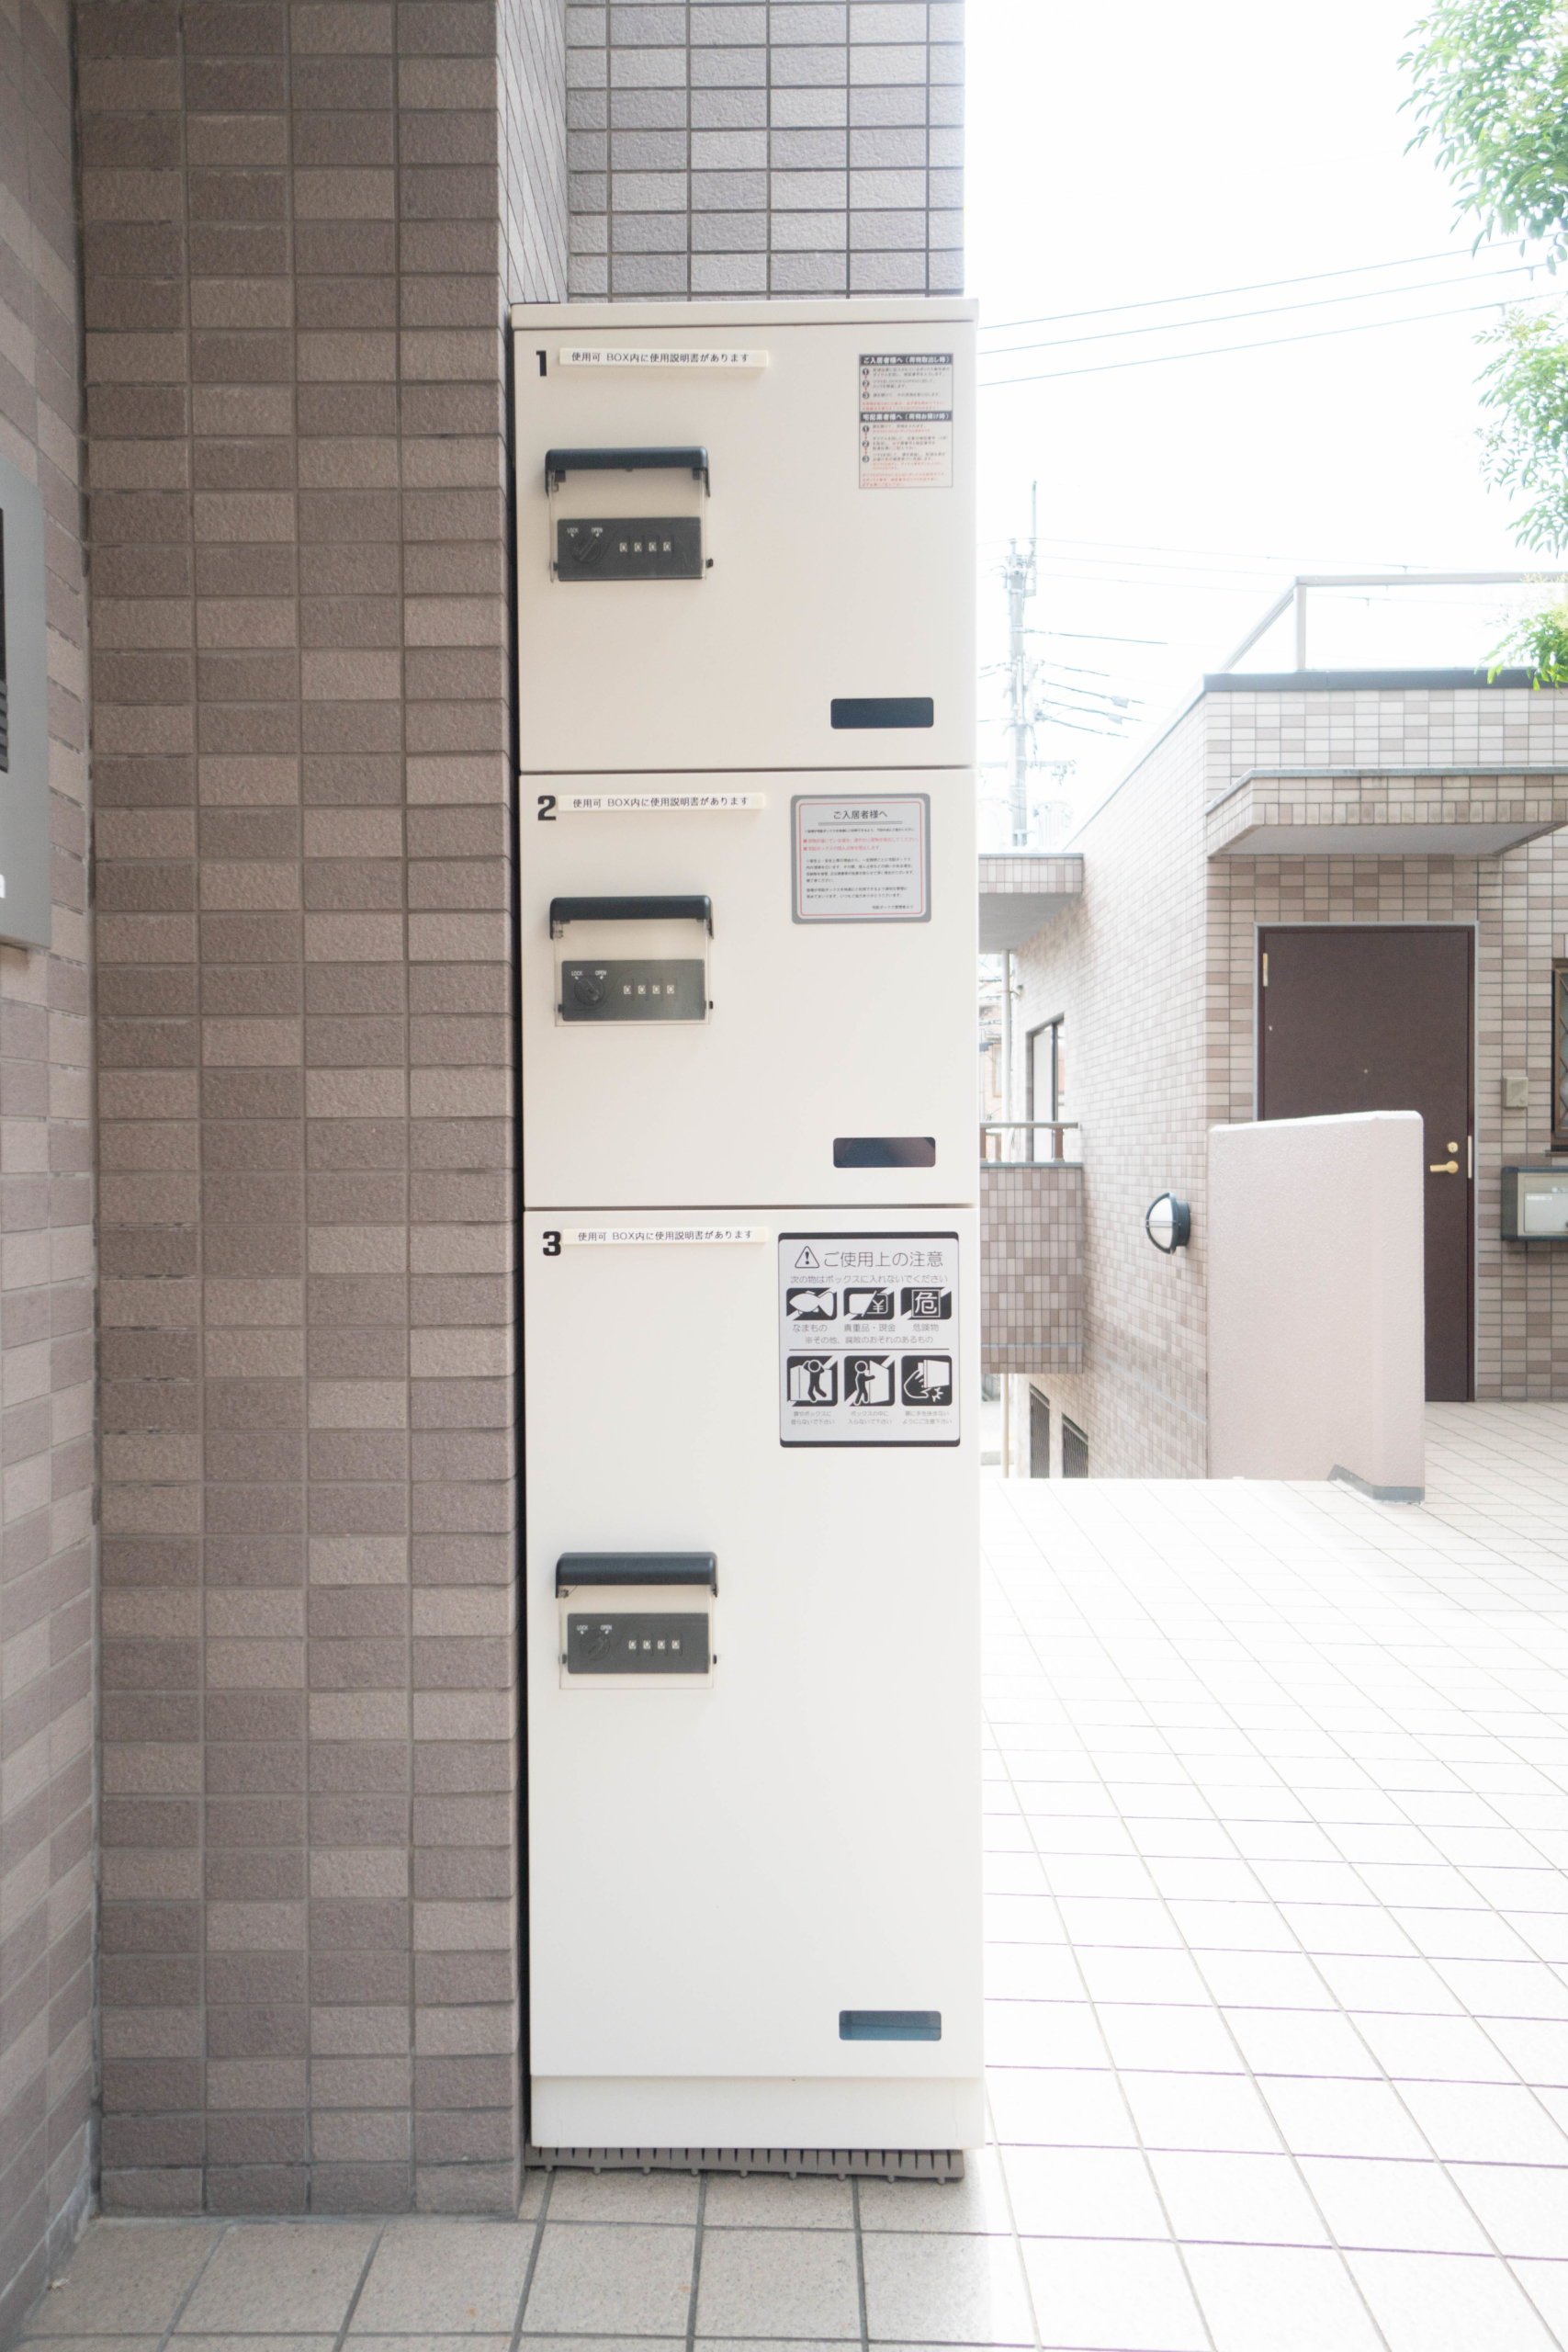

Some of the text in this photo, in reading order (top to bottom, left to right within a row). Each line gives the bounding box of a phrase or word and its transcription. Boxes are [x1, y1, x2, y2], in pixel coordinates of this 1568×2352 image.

[571, 352, 750, 363] 使用可 BOX内に使用説明書があります
[536, 350, 547, 377] 1
[537, 795, 557, 821] 2
[572, 797, 749, 808] 使用可 BOX内に使用説明書があります
[833, 809, 888, 820] ご入居者様へ
[578, 1230, 753, 1241] 使用可 BOX内に使用説明書があります
[543, 1231, 561, 1256] 3
[824, 1251, 944, 1268] ご使用上の注意
[790, 1274, 948, 1284] 次の物はボックスに入れないでください
[914, 1292, 938, 1315] 危
[792, 1323, 828, 1332] なまもの
[844, 1323, 897, 1332] 貴重品・現金
[912, 1323, 939, 1332] 危険物
